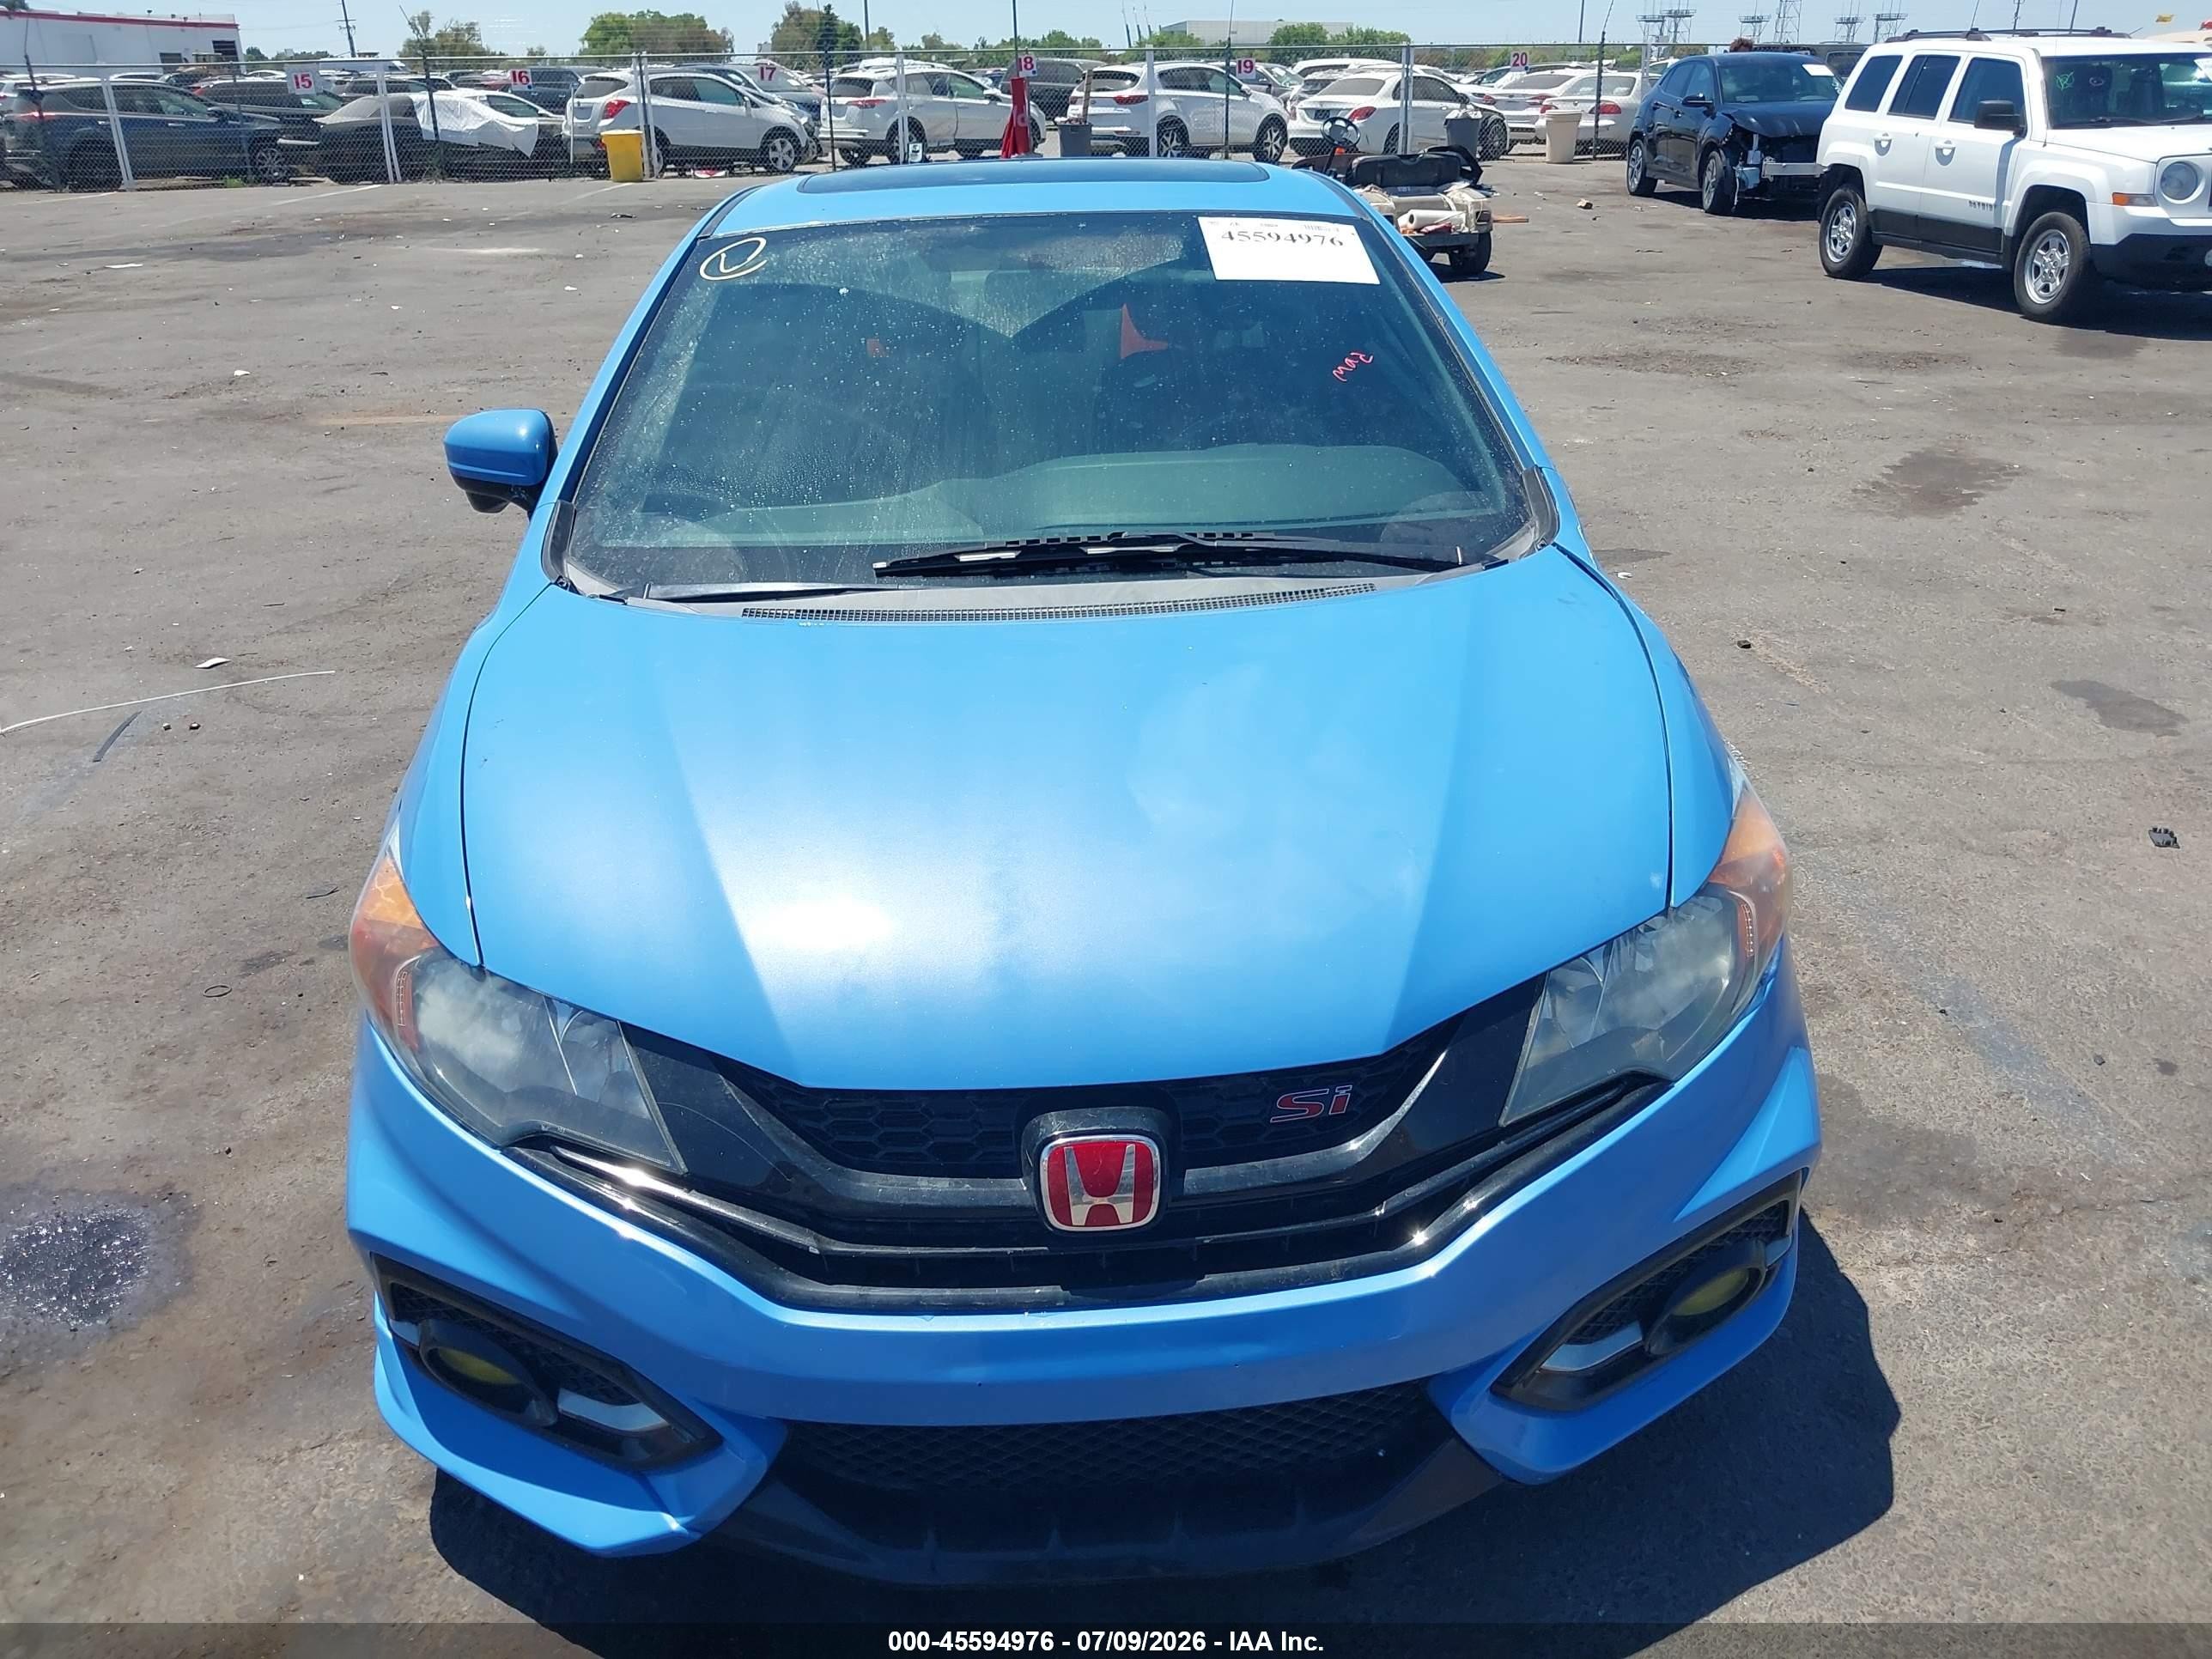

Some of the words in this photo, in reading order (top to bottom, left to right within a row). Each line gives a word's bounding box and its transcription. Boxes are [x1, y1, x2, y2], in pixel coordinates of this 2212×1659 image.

[1018, 56, 1034, 71] 18
[1237, 59, 1254, 74] 19
[1512, 52, 1528, 67] 20
[294, 73, 313, 89] 15
[512, 70, 530, 85] 16
[760, 66, 777, 81] 17
[1221, 230, 1344, 246] 45594976
[1270, 1085, 1352, 1122] Si
